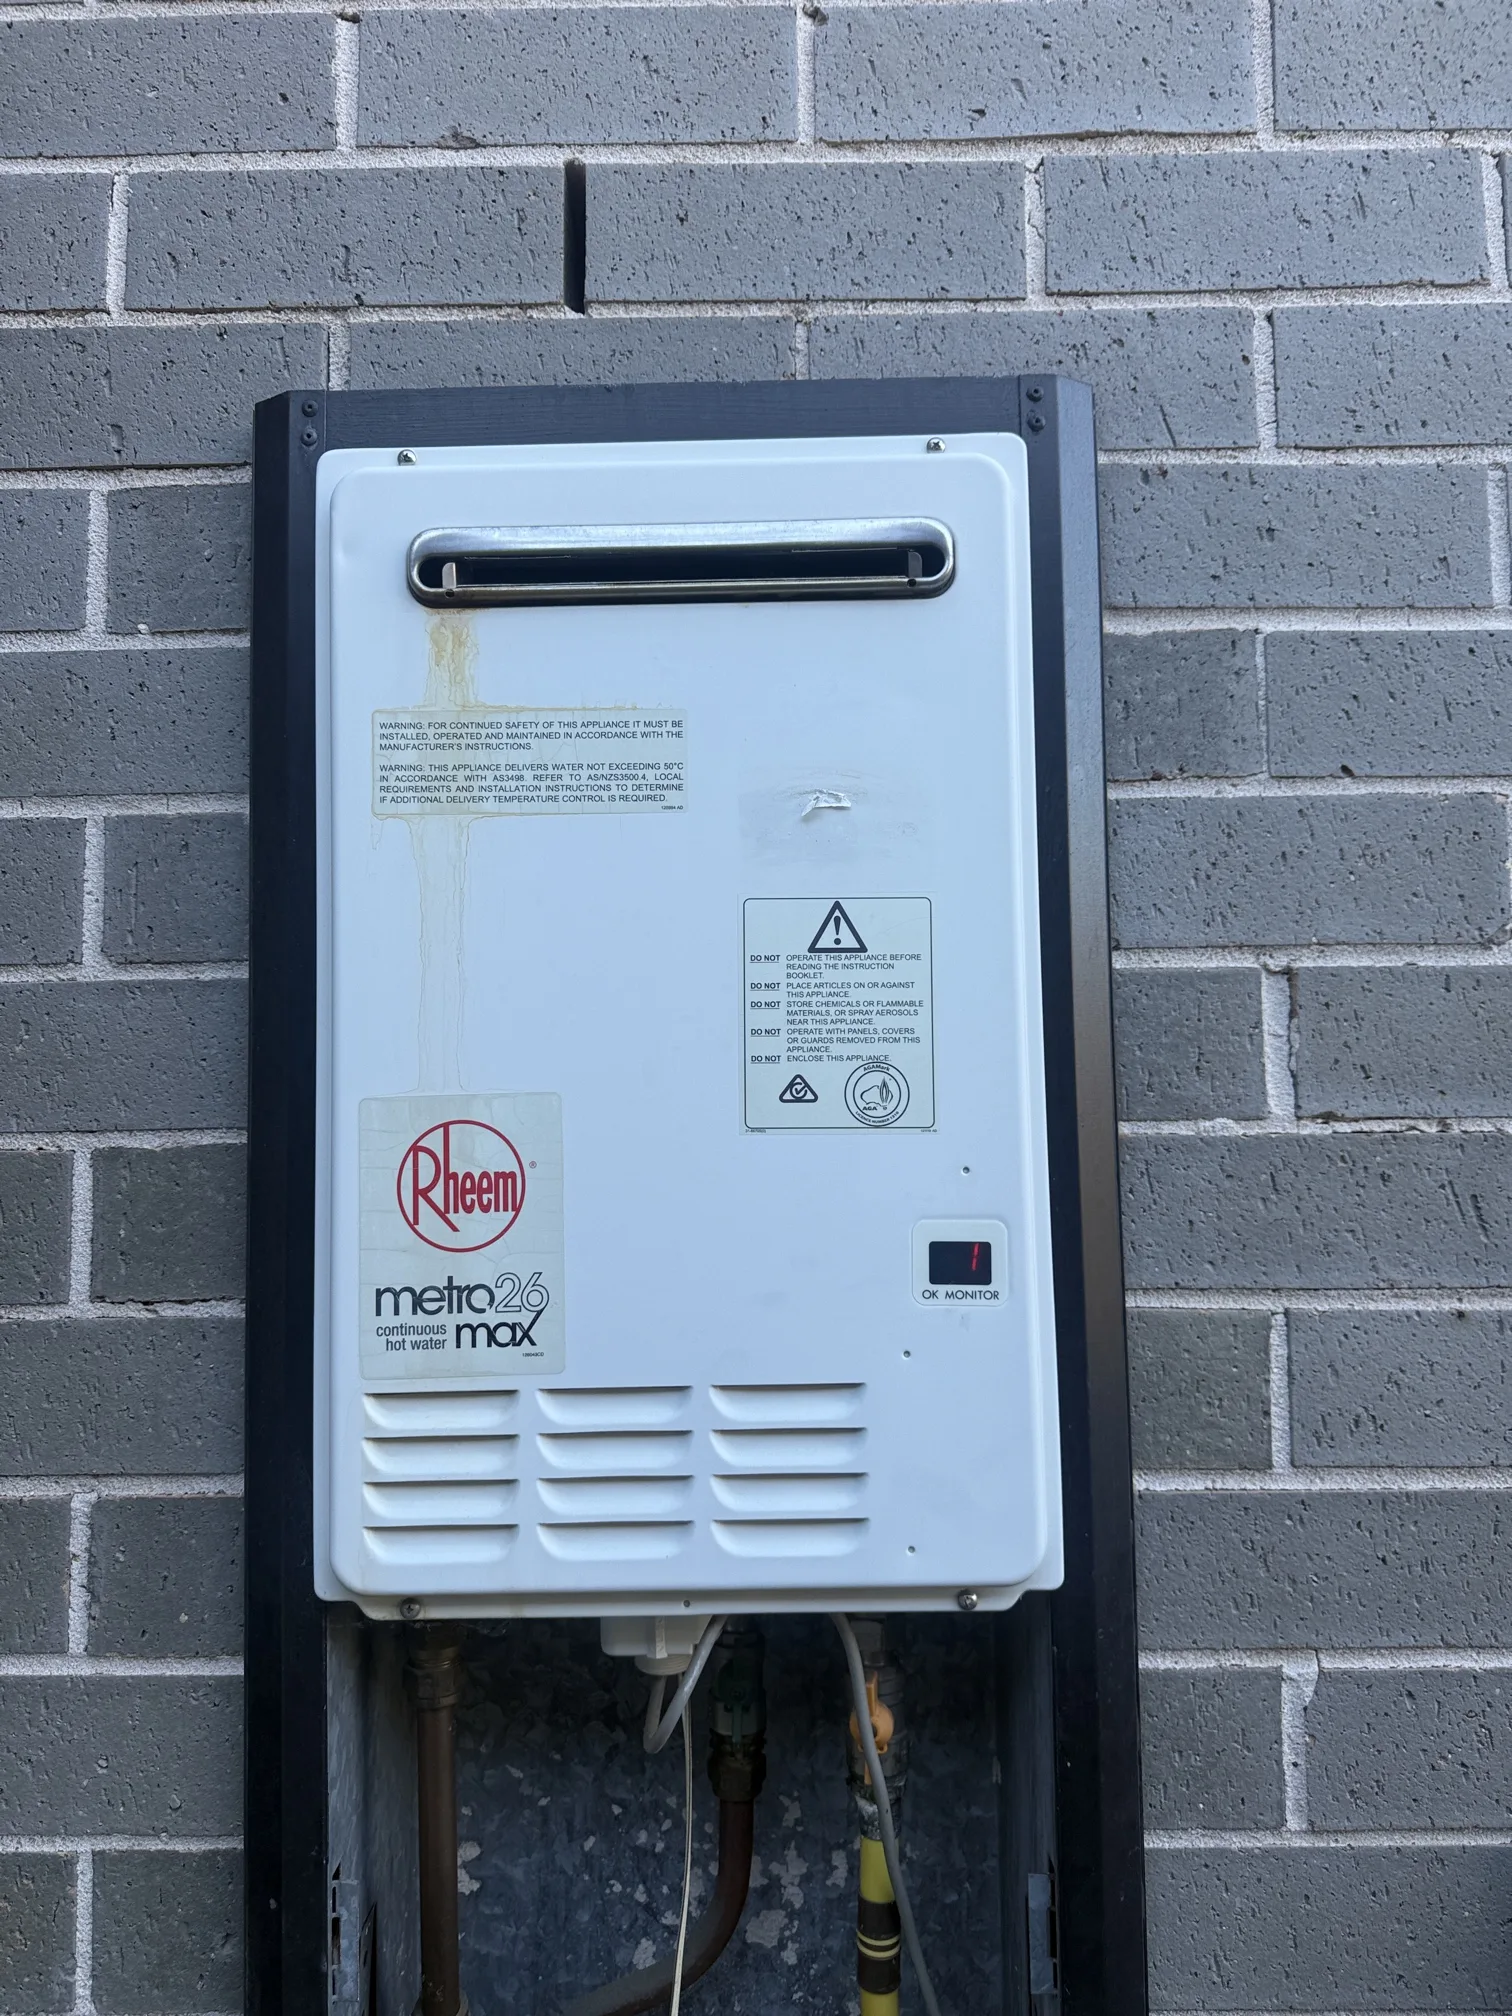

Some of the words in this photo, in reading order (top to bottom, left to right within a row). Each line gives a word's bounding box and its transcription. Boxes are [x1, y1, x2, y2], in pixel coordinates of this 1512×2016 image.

[379, 722, 425, 730] WARNING:
[428, 722, 446, 730] FOR
[450, 722, 502, 730] CONTINUED
[505, 721, 539, 729] SAFETY
[543, 721, 554, 729] OF
[644, 720, 669, 728] MUST
[671, 720, 683, 728] BE
[379, 733, 431, 741] INSTALLED,
[433, 732, 482, 740] OPERATED
[485, 732, 503, 740] AND
[506, 732, 561, 740] MAINTAINED
[575, 731, 638, 739] ACCORDANCE
[379, 743, 462, 751] MANUFACTURER'S
[465, 742, 533, 750] INSTRUCTIONS.
[379, 764, 425, 772] WARNING:
[429, 764, 449, 772] THIS
[505, 763, 549, 771] DELIVERS
[552, 763, 584, 771] WATER
[587, 763, 605, 771] NOT
[379, 775, 389, 783] IN
[492, 774, 527, 782] AS3498.
[587, 773, 649, 782] AS/NZS3500.4,
[654, 773, 684, 781] LOCAL
[379, 785, 451, 793] REQUIREMENTS
[455, 785, 474, 793] AND
[478, 785, 541, 793] INSTALLATION
[545, 784, 612, 792] INSTRUCTIONS
[632, 783, 684, 791] DETERMINE
[379, 796, 387, 804] IF
[390, 796, 443, 804] ADDITIONAL
[446, 795, 490, 803] DELIVERY
[493, 795, 559, 803] TEMPERATURE
[619, 794, 667, 802] REQUIRED.
[410, 1123, 518, 1232] Rheem
[972, 1243, 979, 1271] 1
[922, 1289, 939, 1299] OK
[945, 1290, 999, 1300] MONITOR
[376, 1323, 447, 1336] continuous
[456, 1316, 542, 1348] max
[385, 1338, 406, 1351] hot
[409, 1338, 447, 1350] water
